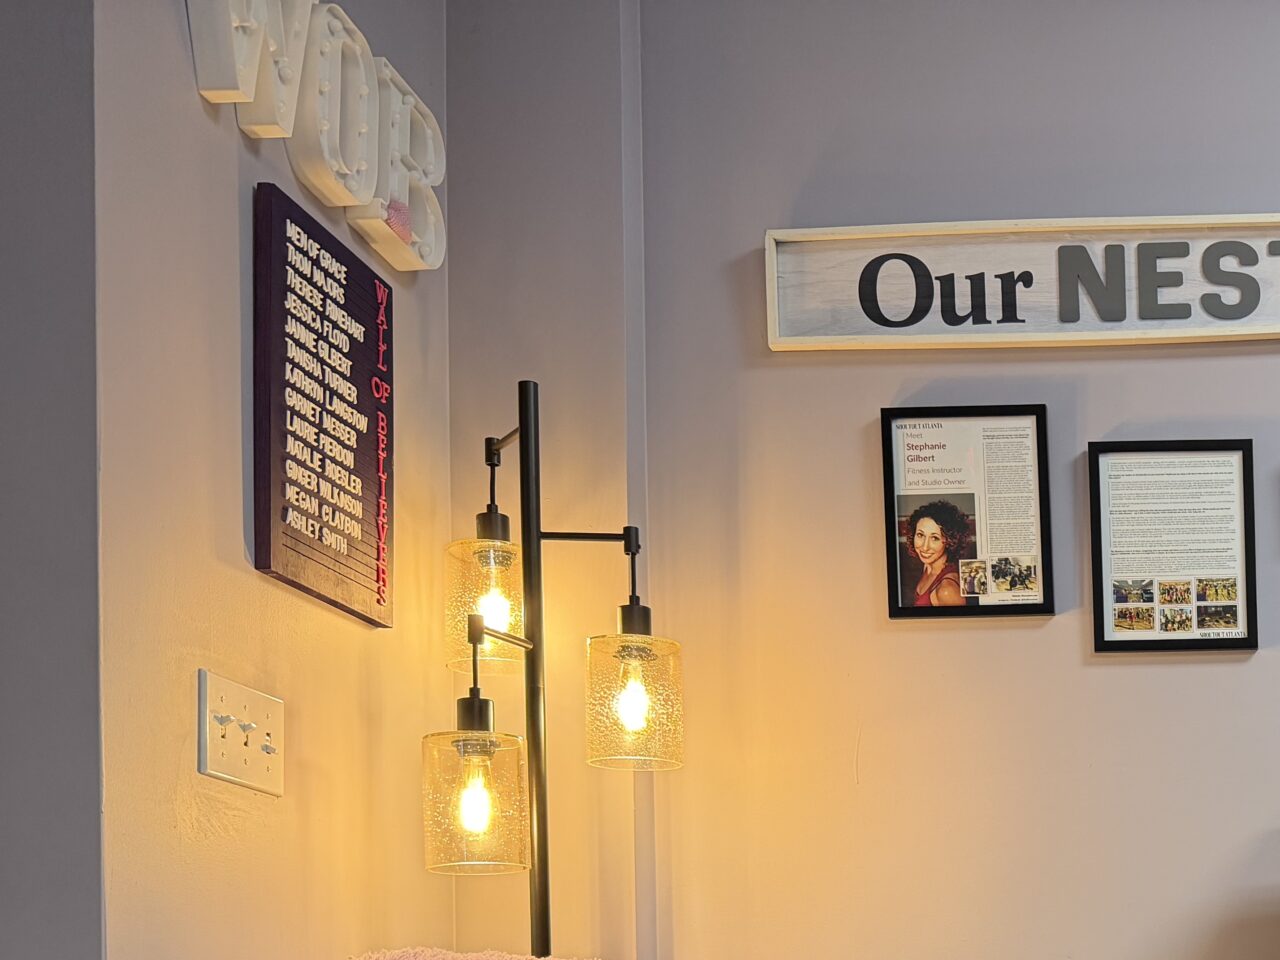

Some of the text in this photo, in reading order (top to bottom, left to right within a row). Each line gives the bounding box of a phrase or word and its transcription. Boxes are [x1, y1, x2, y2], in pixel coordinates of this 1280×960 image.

[308, 237, 319, 262] OF
[320, 247, 347, 285] GRACE
[285, 266, 324, 311] THERESE
[857, 252, 1033, 328] Our
[284, 290, 349, 354] JESSICA FLOYD
[374, 279, 389, 372] WALL
[318, 339, 352, 378] GILBERT
[322, 365, 357, 404] TURNER
[371, 376, 391, 403] OF
[286, 410, 318, 446] LAURIE
[325, 390, 368, 434] LANGSTON
[286, 434, 322, 472] NATALIE
[906, 442, 946, 451] Stephanie
[907, 454, 935, 463] Gilbert
[285, 458, 362, 518] GINGER WILKINSON
[907, 466, 930, 474] Fitness
[907, 478, 920, 486] and
[922, 478, 942, 486] Studio
[286, 507, 347, 554] ASHLEY SMITH
